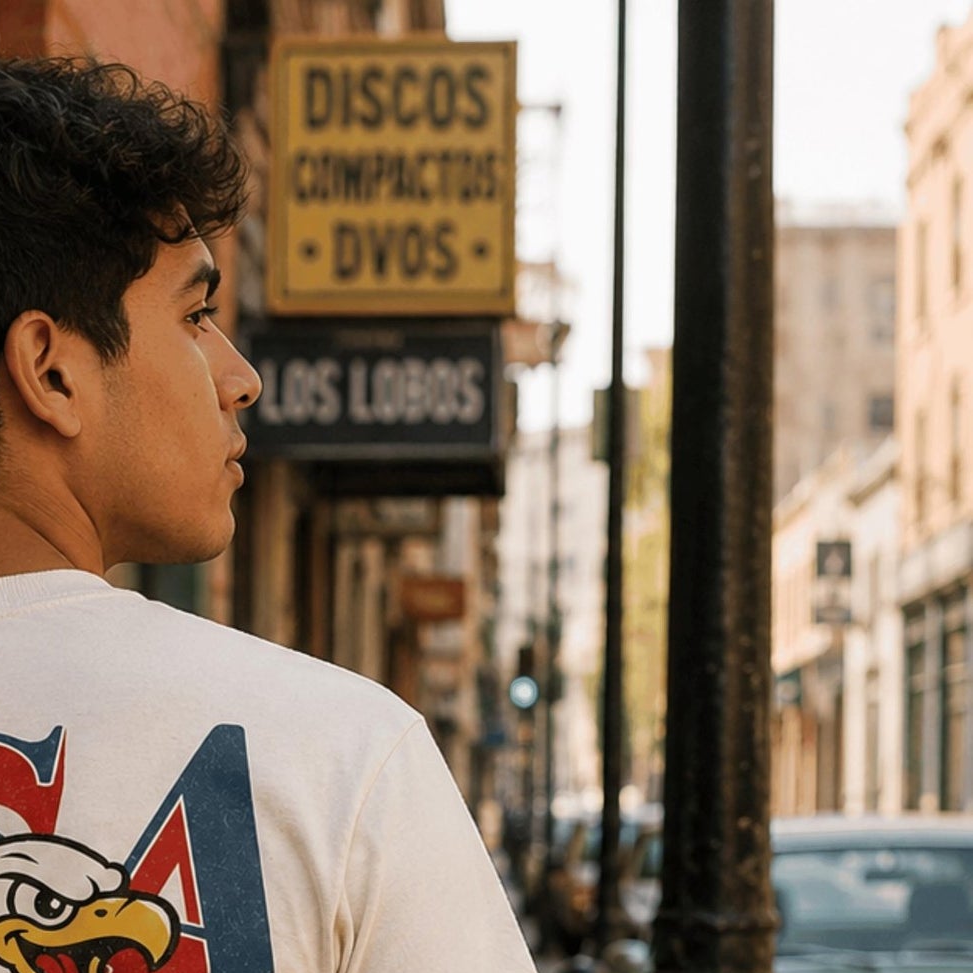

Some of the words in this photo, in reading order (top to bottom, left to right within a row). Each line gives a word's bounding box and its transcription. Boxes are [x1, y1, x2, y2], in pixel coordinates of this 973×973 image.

[304, 63, 491, 130] DISCOS
[259, 357, 342, 425] LOS
[348, 357, 485, 425] LOBOS
